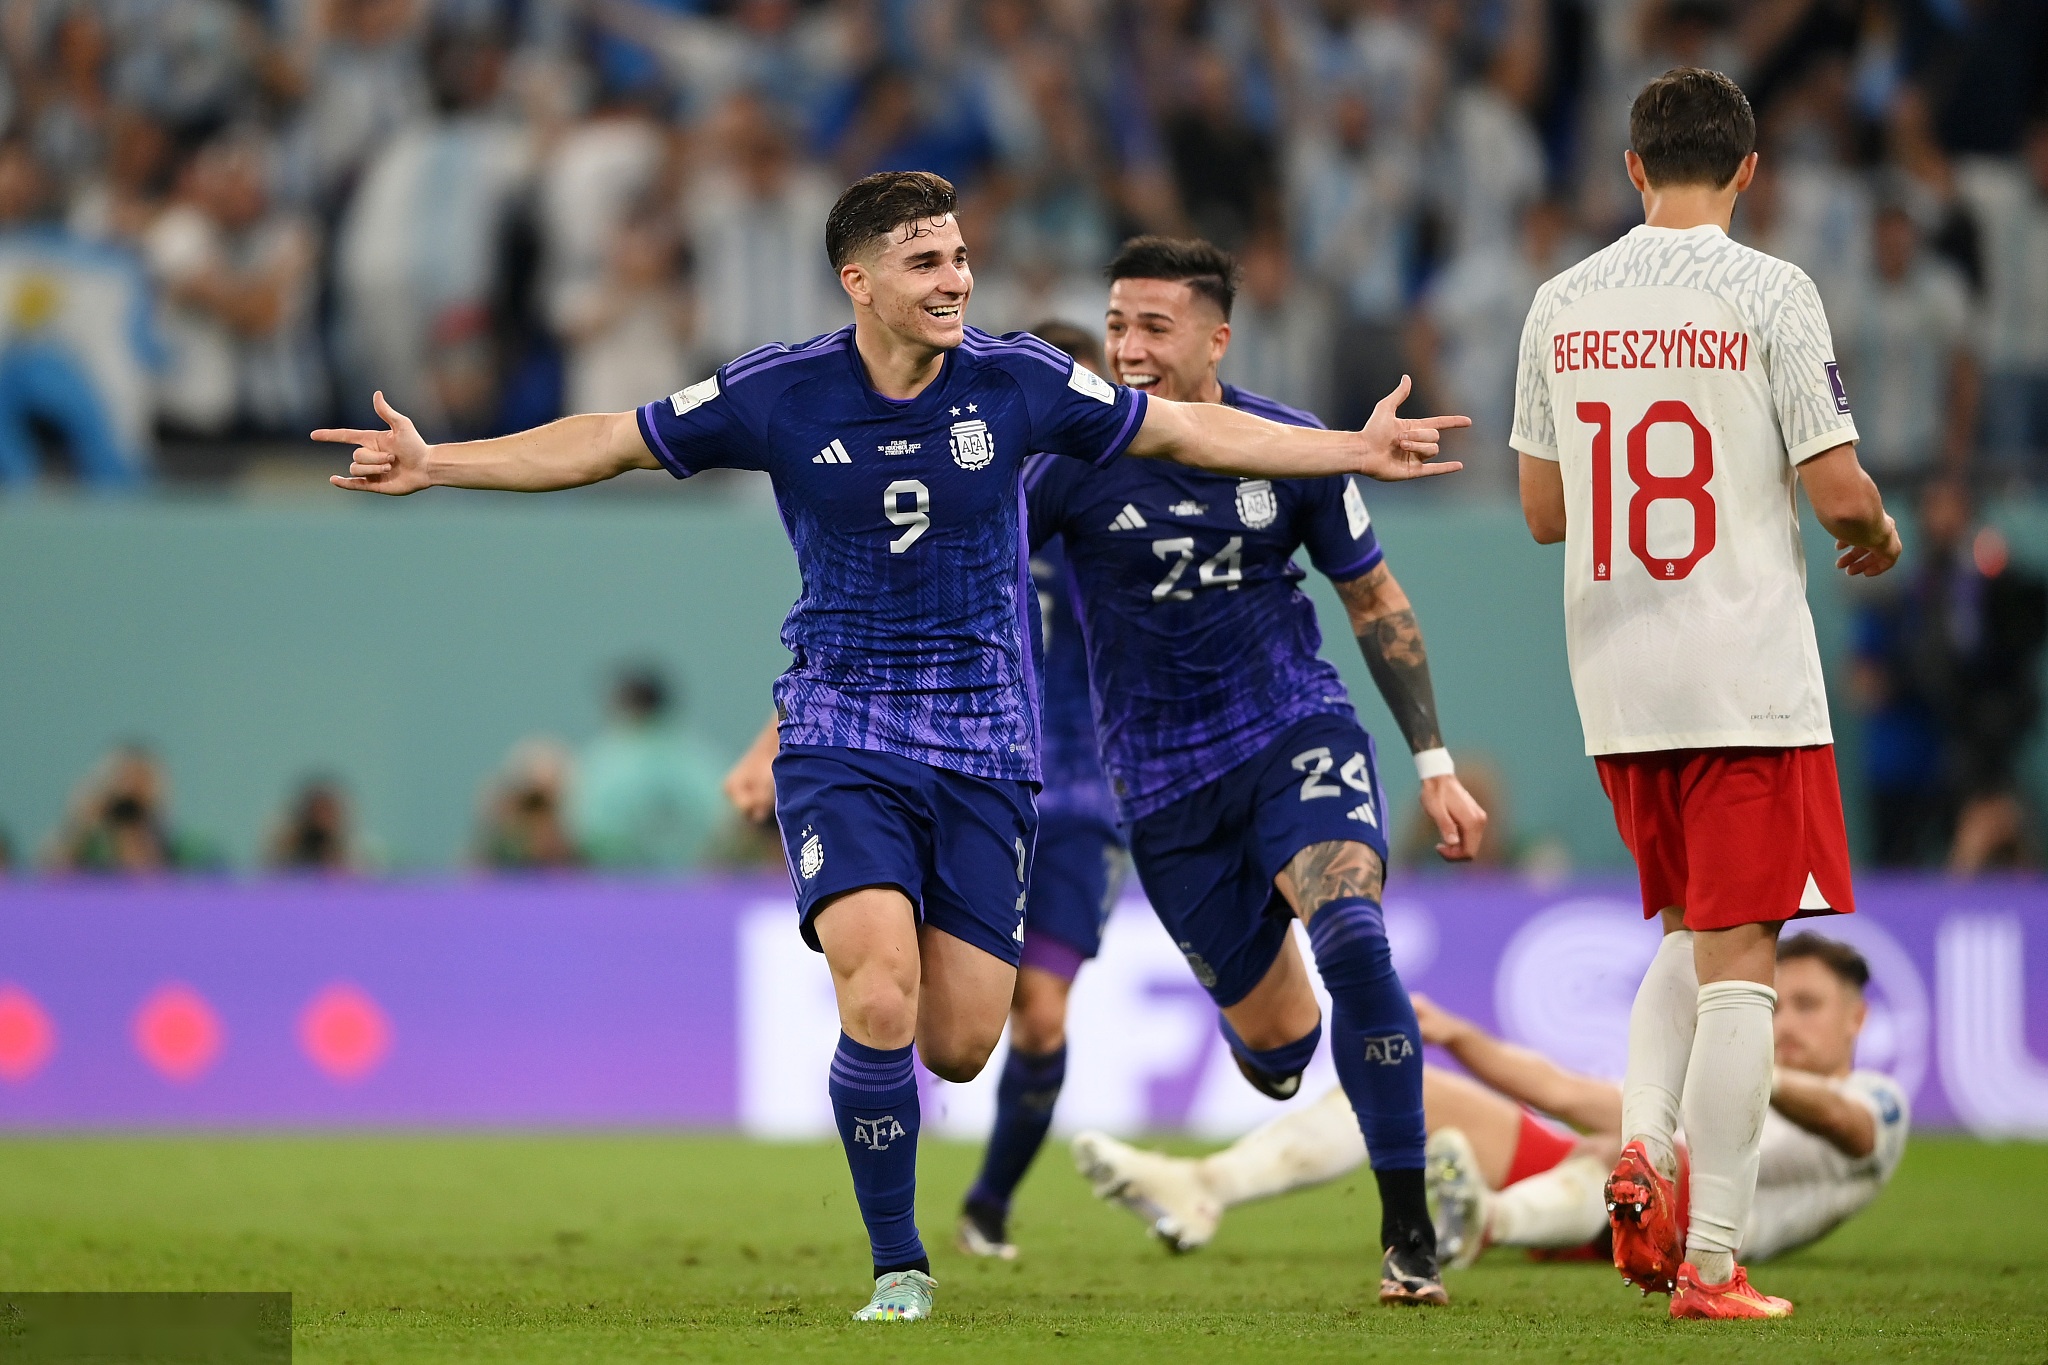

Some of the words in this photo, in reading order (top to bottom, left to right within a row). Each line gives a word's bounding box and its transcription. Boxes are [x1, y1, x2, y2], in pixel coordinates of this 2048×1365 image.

[1554, 322, 1748, 374] BERESZYŃSKI
[884, 479, 930, 554] 9
[1576, 400, 1716, 581] 18
[1152, 536, 1243, 600] 24
[1291, 747, 1375, 810] 24
[1364, 1033, 1414, 1065] AFA
[853, 1115, 906, 1151] AFA
